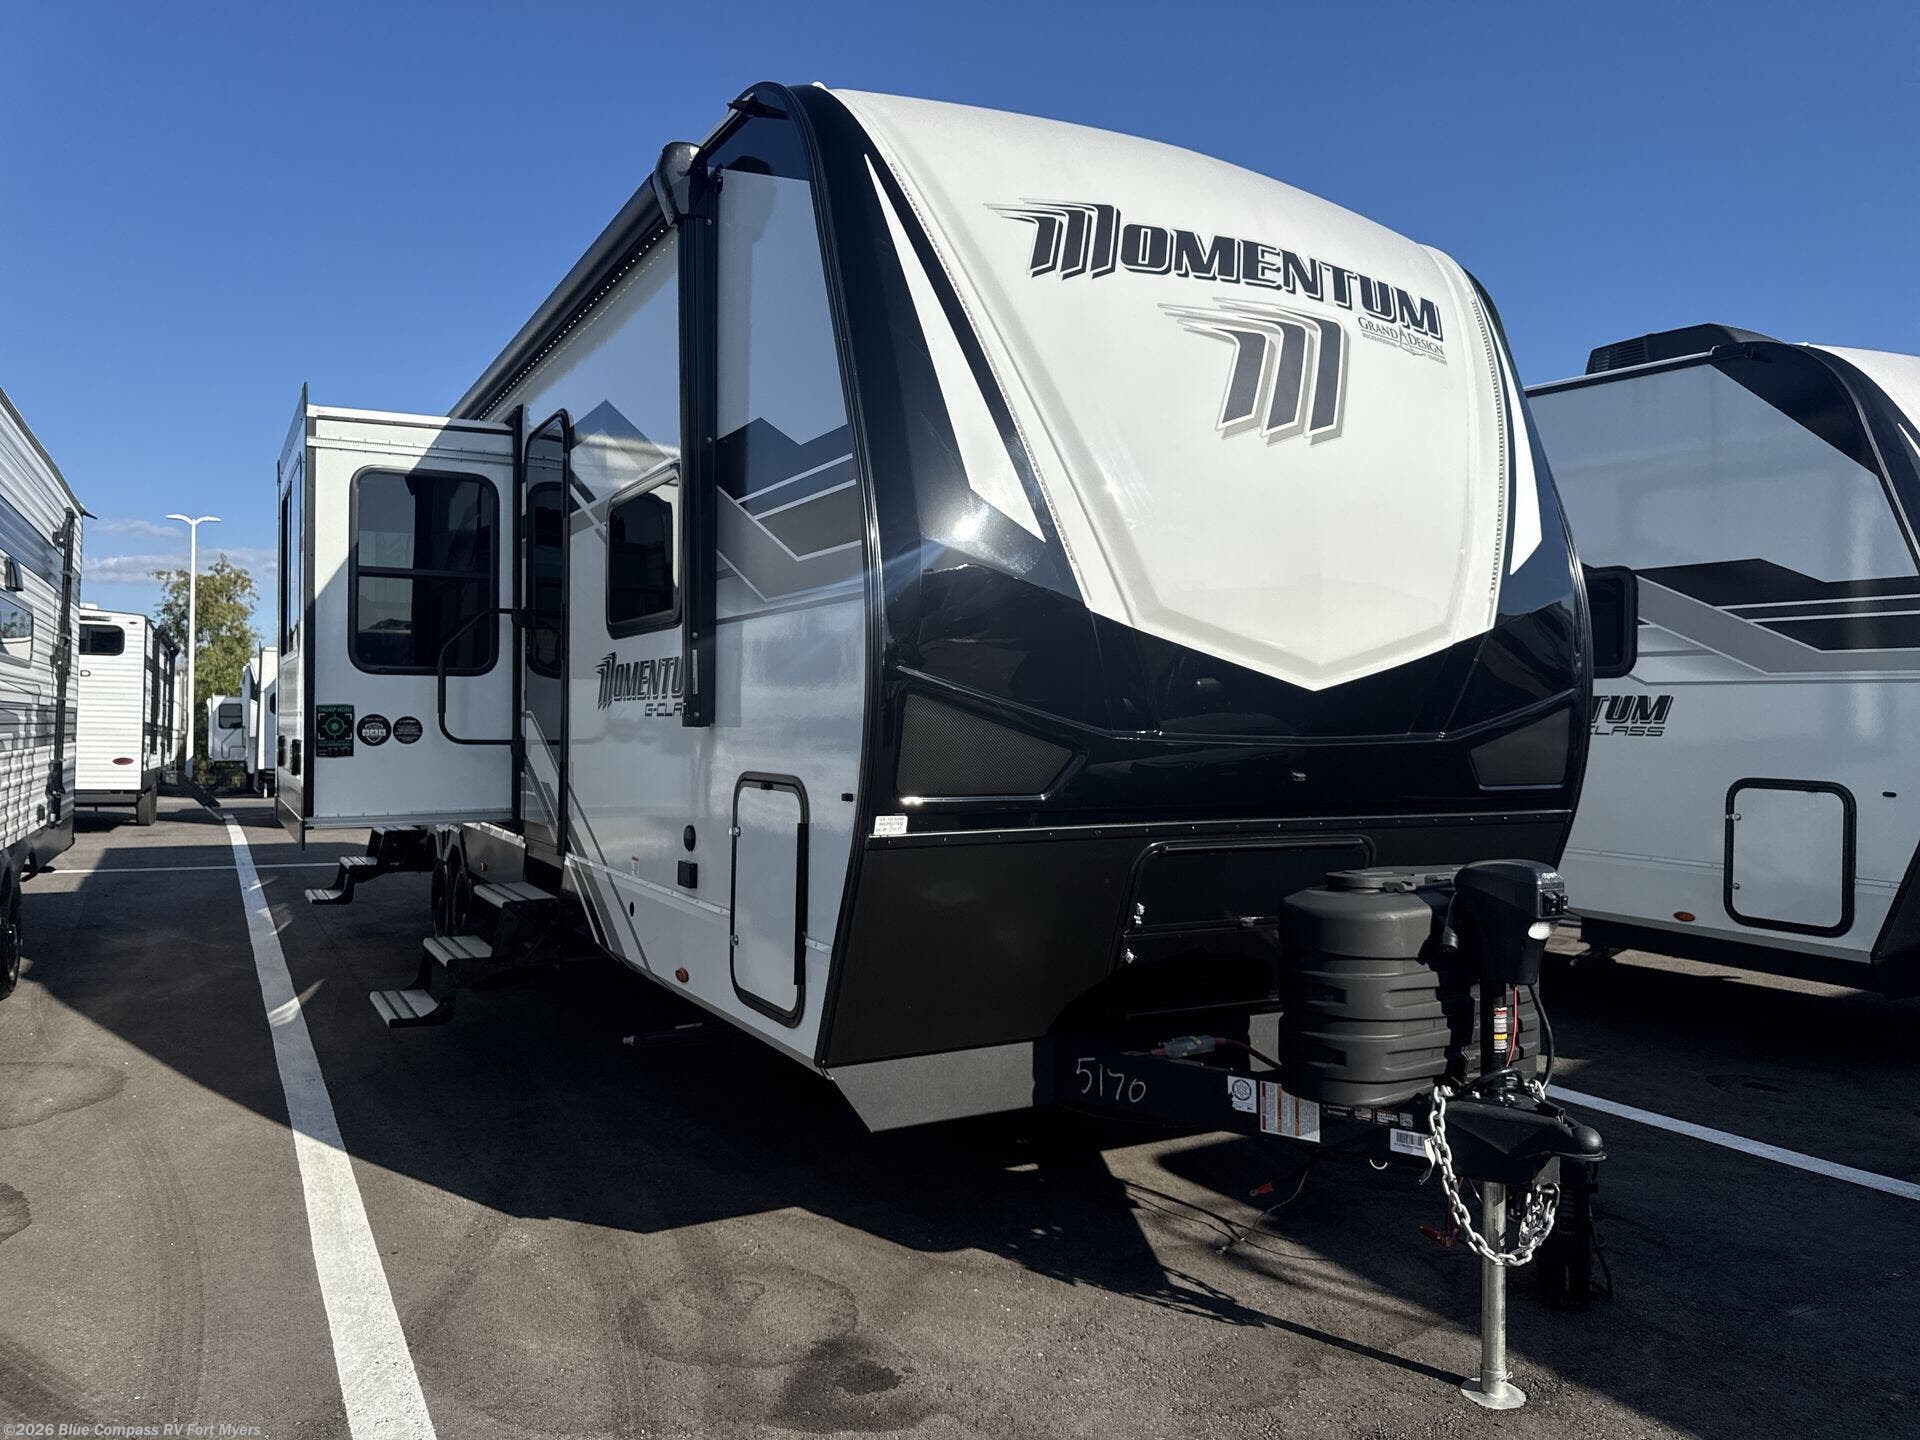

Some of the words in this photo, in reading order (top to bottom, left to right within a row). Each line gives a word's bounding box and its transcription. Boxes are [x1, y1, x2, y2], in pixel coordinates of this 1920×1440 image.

[984, 197, 1444, 342] MOMENTUM
[1358, 317, 1398, 339] GRAND
[1408, 333, 1444, 355] DESIGN
[1075, 1057, 1146, 1103] 5170
